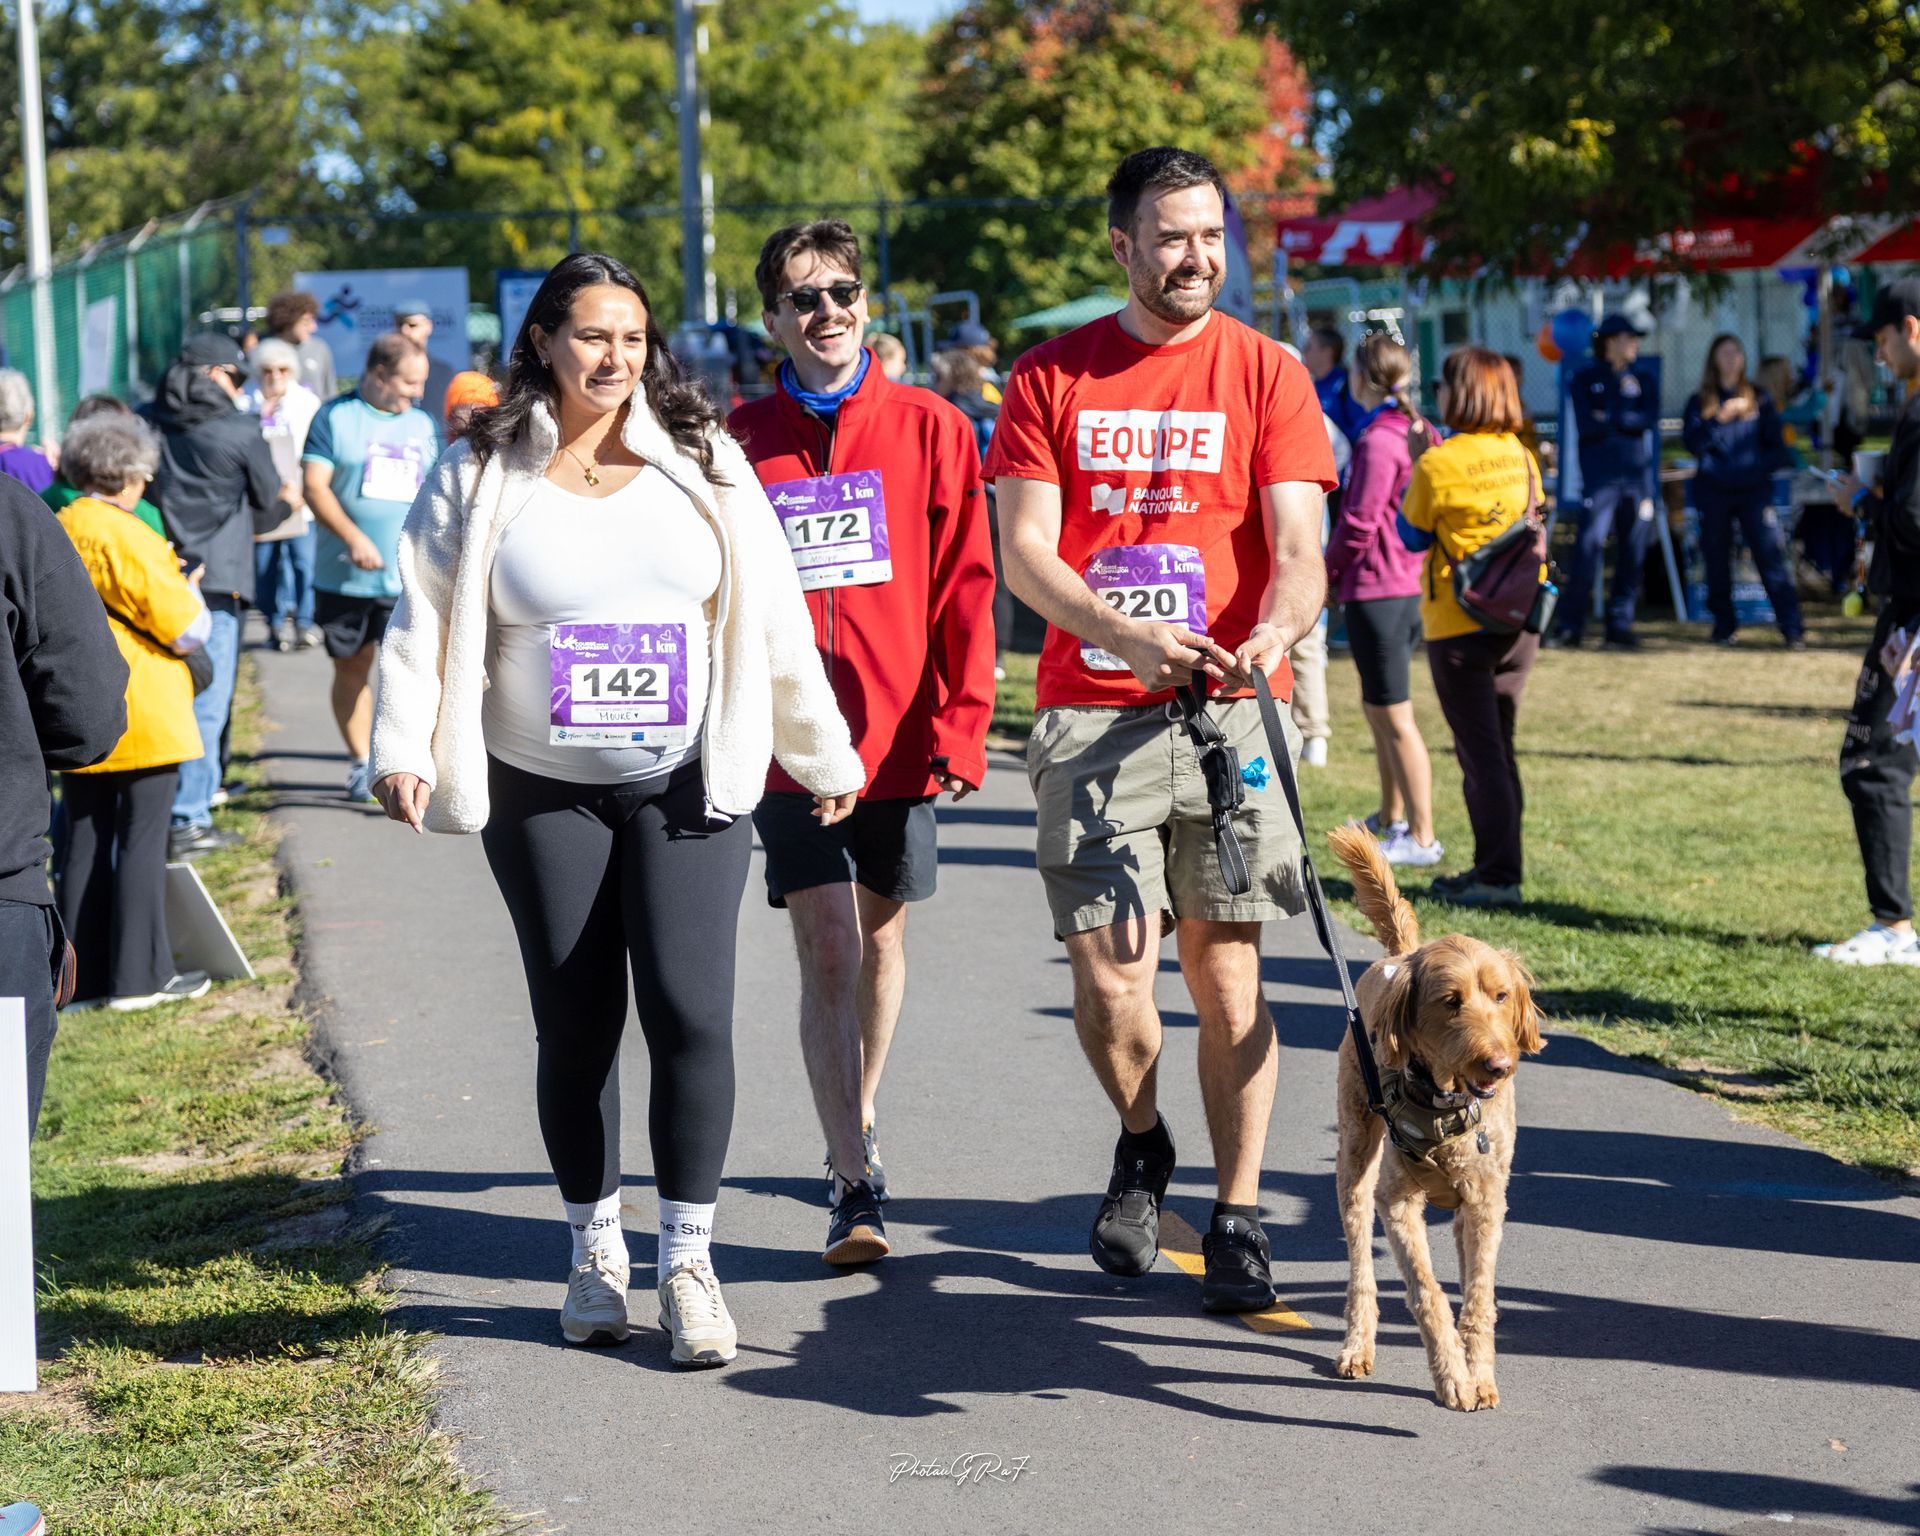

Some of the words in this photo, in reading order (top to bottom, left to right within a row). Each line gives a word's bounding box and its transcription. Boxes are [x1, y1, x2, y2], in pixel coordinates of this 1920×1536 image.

[1090, 417, 1211, 464] ÉQUIPE
[841, 482, 853, 501] 1
[855, 486, 874, 499] km
[1133, 486, 1183, 500] BANQUE
[1128, 500, 1200, 514] NATIONALE
[795, 512, 860, 544] 172
[1158, 554, 1171, 575] 1
[1174, 560, 1194, 573] km
[1105, 588, 1177, 618] 220
[640, 633, 653, 654] 1
[656, 638, 677, 654] km
[583, 667, 658, 697] 142
